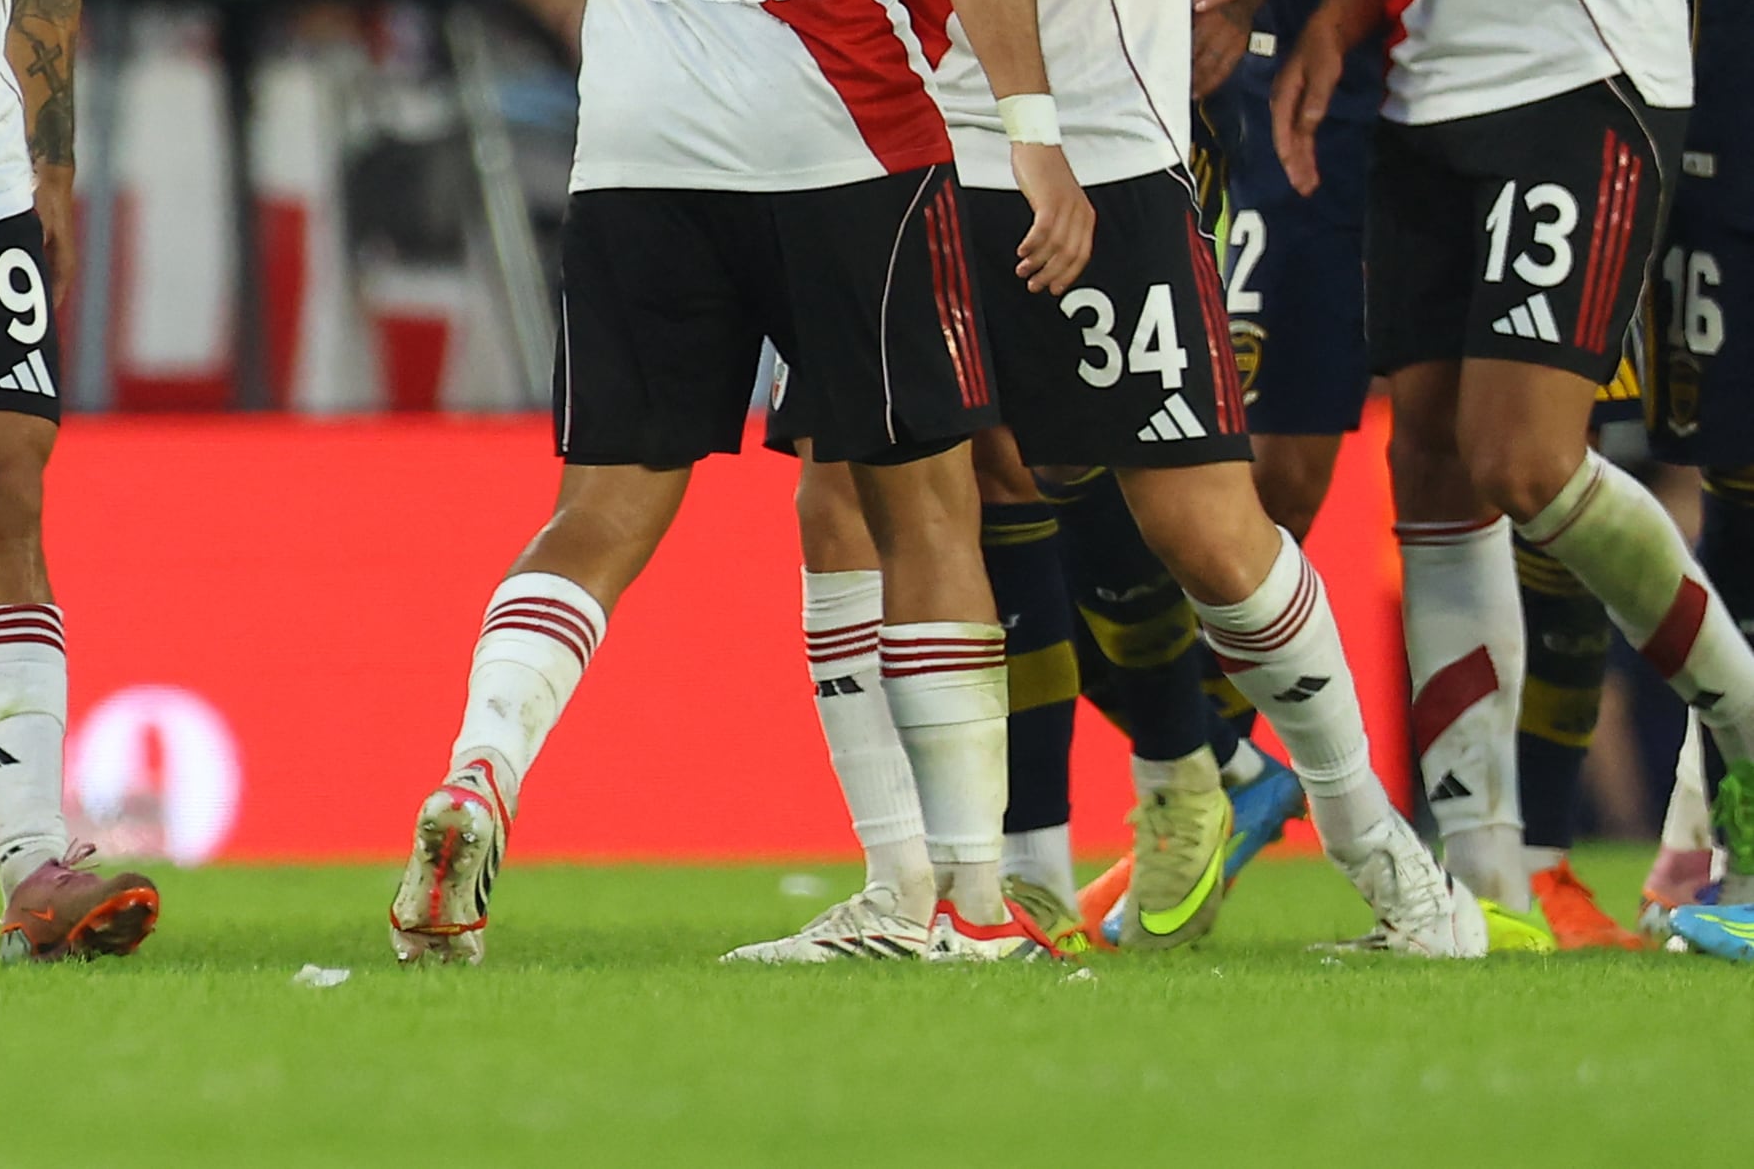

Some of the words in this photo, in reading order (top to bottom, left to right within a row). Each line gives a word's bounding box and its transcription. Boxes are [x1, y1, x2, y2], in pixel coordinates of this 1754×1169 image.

[1483, 179, 1580, 287] 13
[1058, 283, 1189, 391] 34
[1662, 246, 1725, 355] 16
